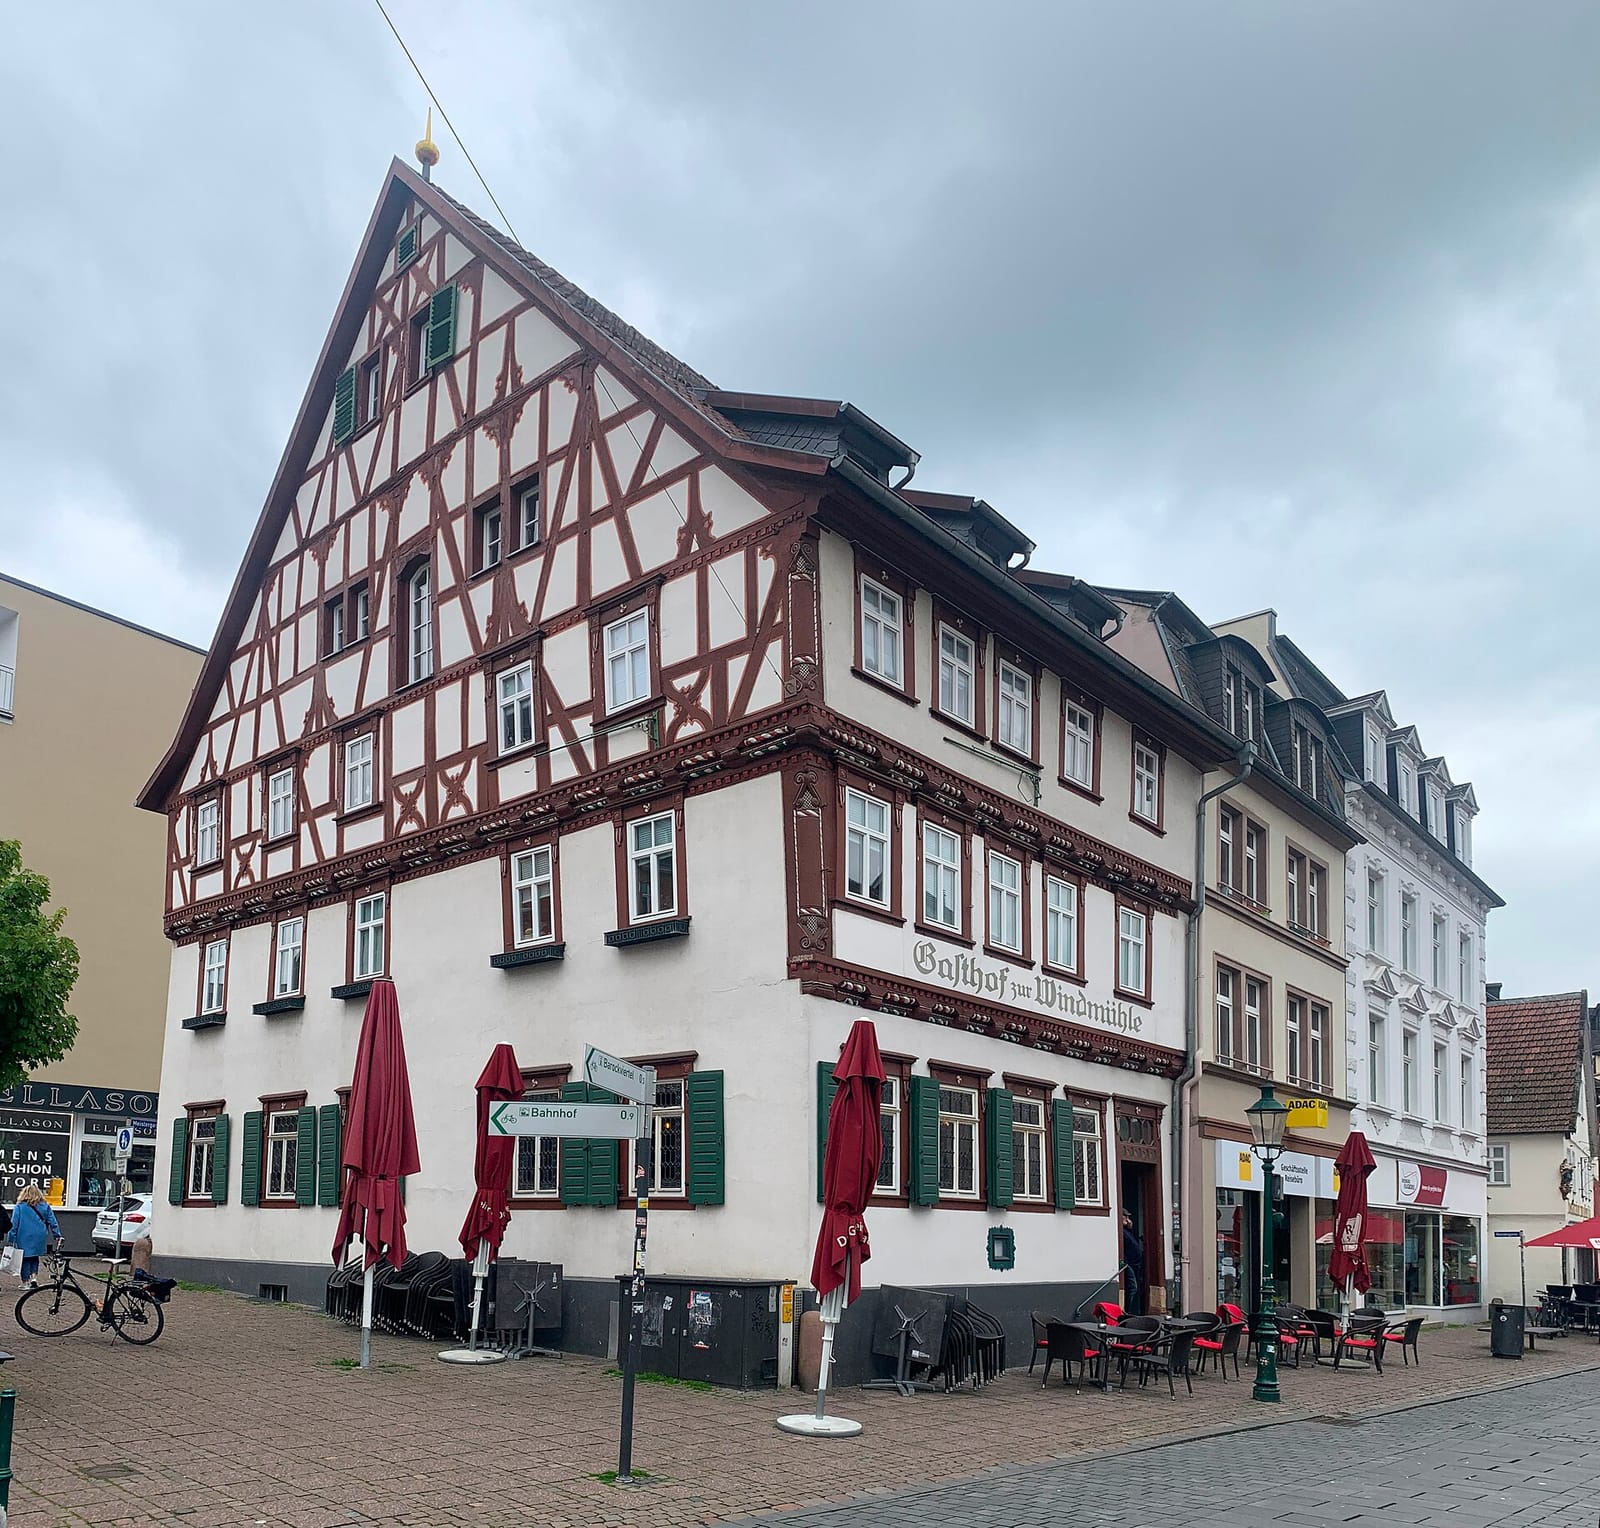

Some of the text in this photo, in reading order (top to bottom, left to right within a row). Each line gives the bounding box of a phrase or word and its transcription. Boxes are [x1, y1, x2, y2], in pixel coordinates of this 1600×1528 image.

[1010, 981, 1033, 1000] zur
[1034, 976, 1143, 1033] Windmühle
[603, 1058, 635, 1080] Barockviertel
[0, 1083, 159, 1114] LLASO
[1288, 1100, 1316, 1109] ADAC
[531, 1107, 634, 1120] Bahnhof 0,9
[1239, 1152, 1252, 1163] ADAC
